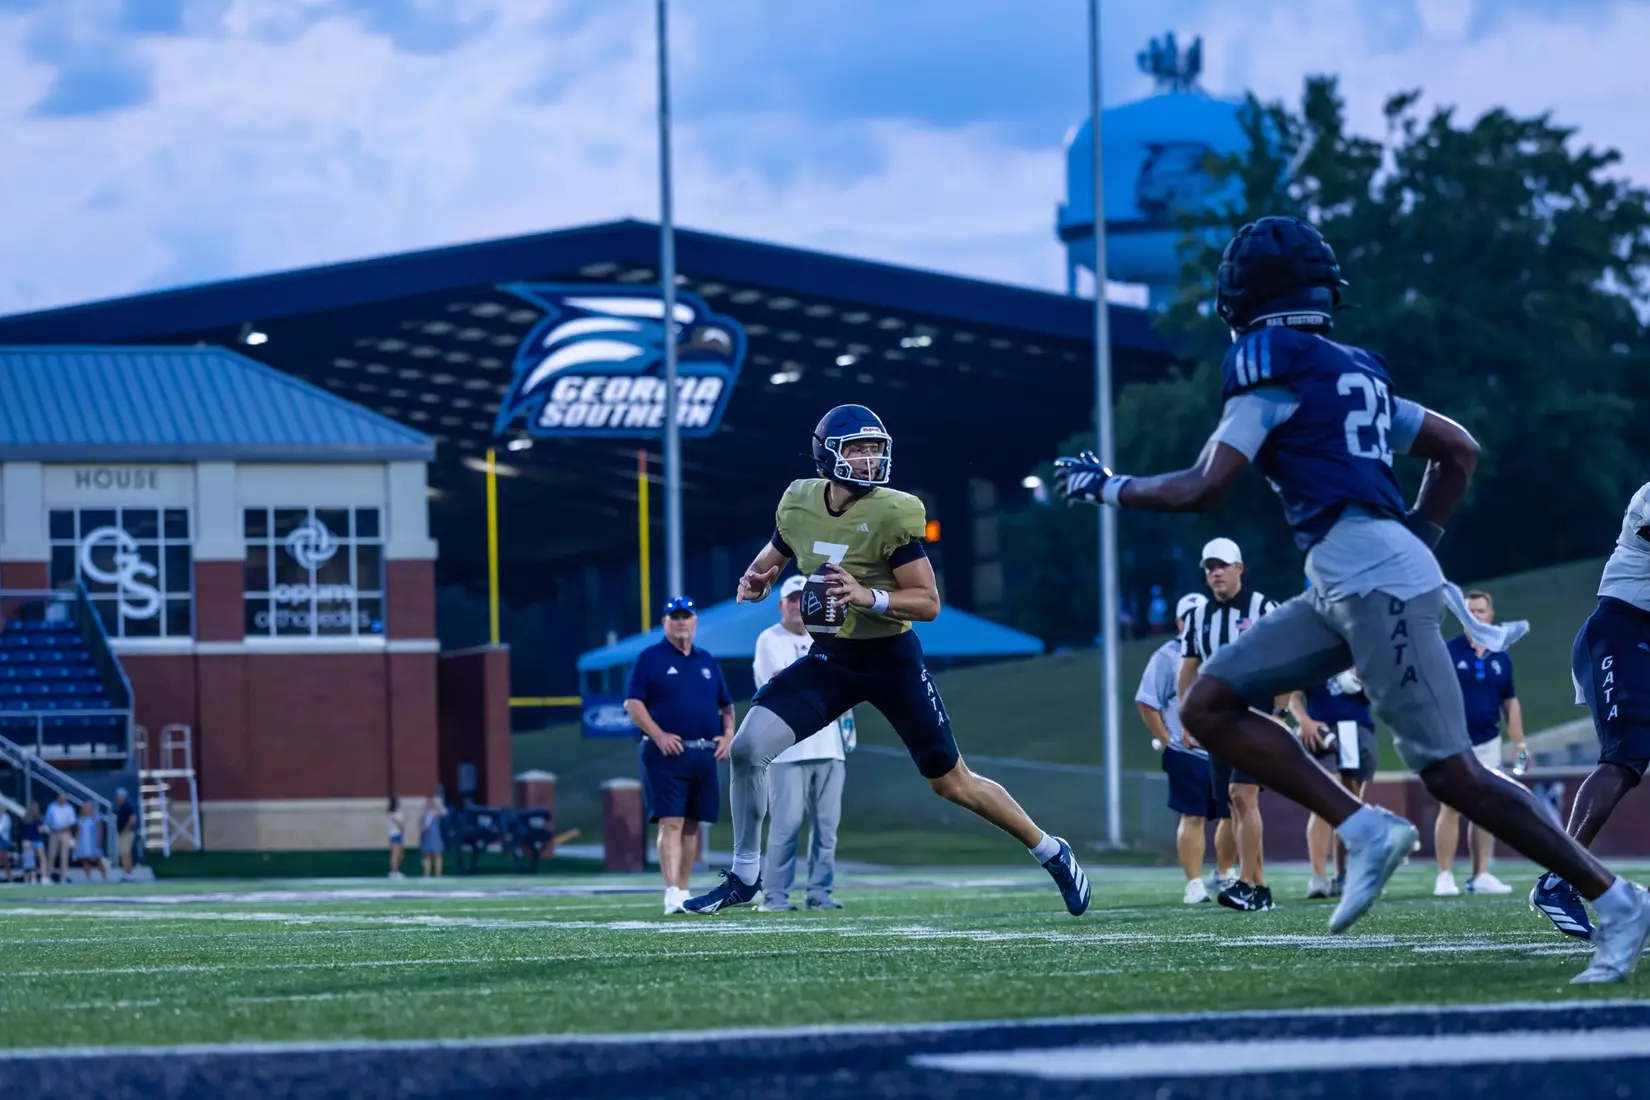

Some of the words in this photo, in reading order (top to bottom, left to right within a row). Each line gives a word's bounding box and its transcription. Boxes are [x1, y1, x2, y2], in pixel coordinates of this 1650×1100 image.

[75, 468, 159, 490] HOUSE
[813, 541, 849, 566] 7
[921, 669, 944, 726] GATA
[1602, 656, 1618, 721] GATA
